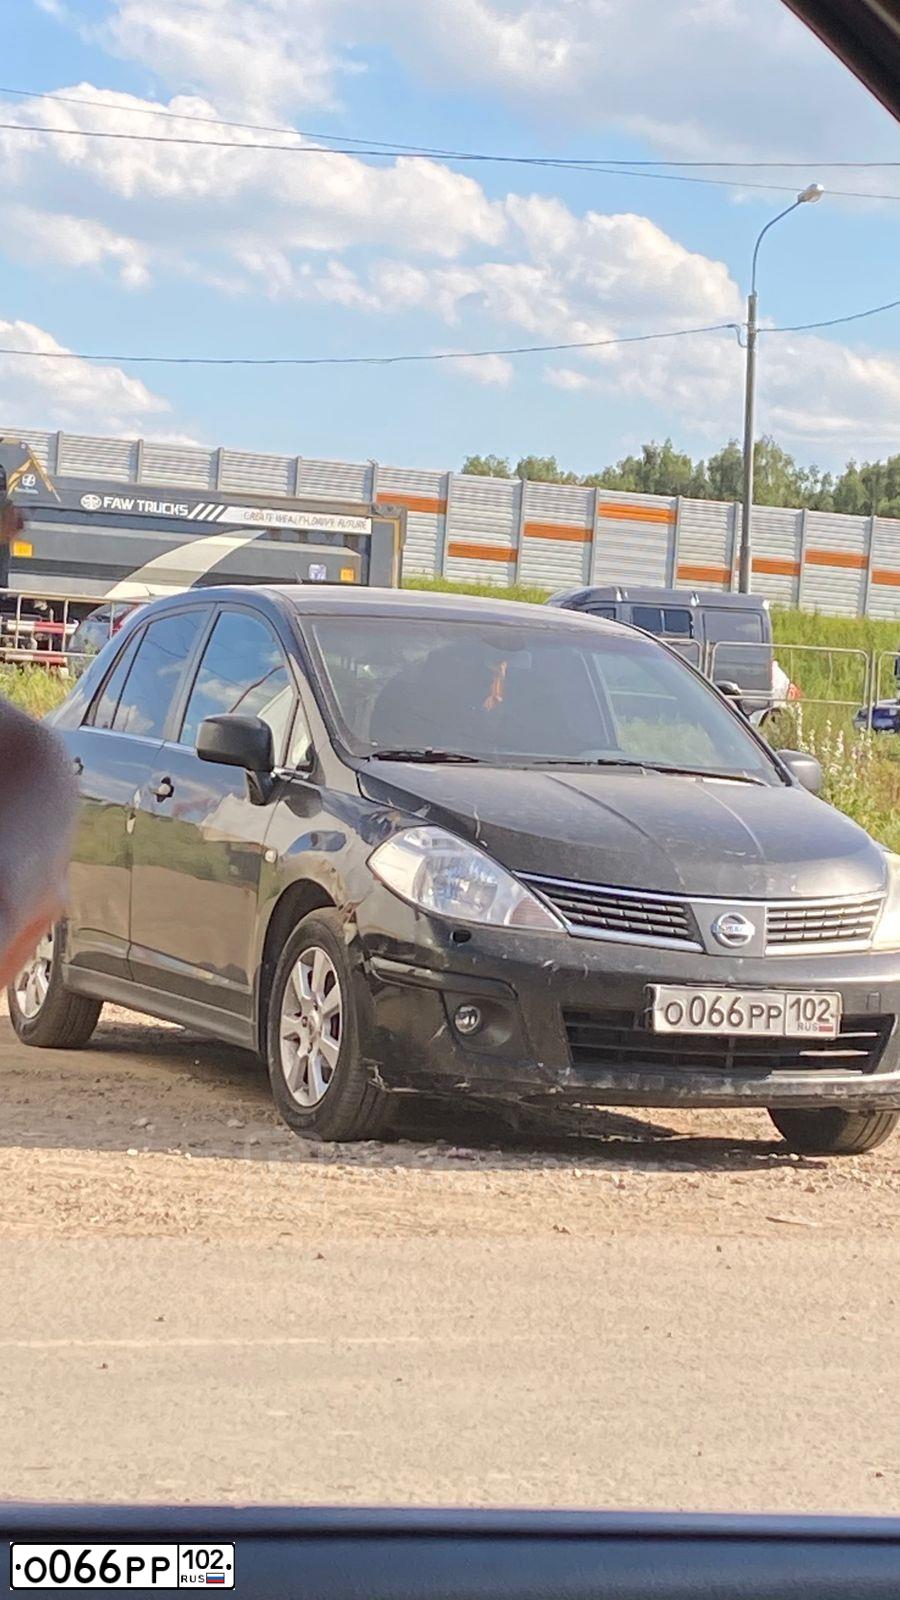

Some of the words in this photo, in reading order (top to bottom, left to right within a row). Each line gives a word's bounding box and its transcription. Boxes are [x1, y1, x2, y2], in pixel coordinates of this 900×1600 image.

[103, 496, 135, 511] FAW
[137, 499, 189, 516] TRUCKS
[789, 997, 831, 1022] 102
[797, 1022, 818, 1032] RUS
